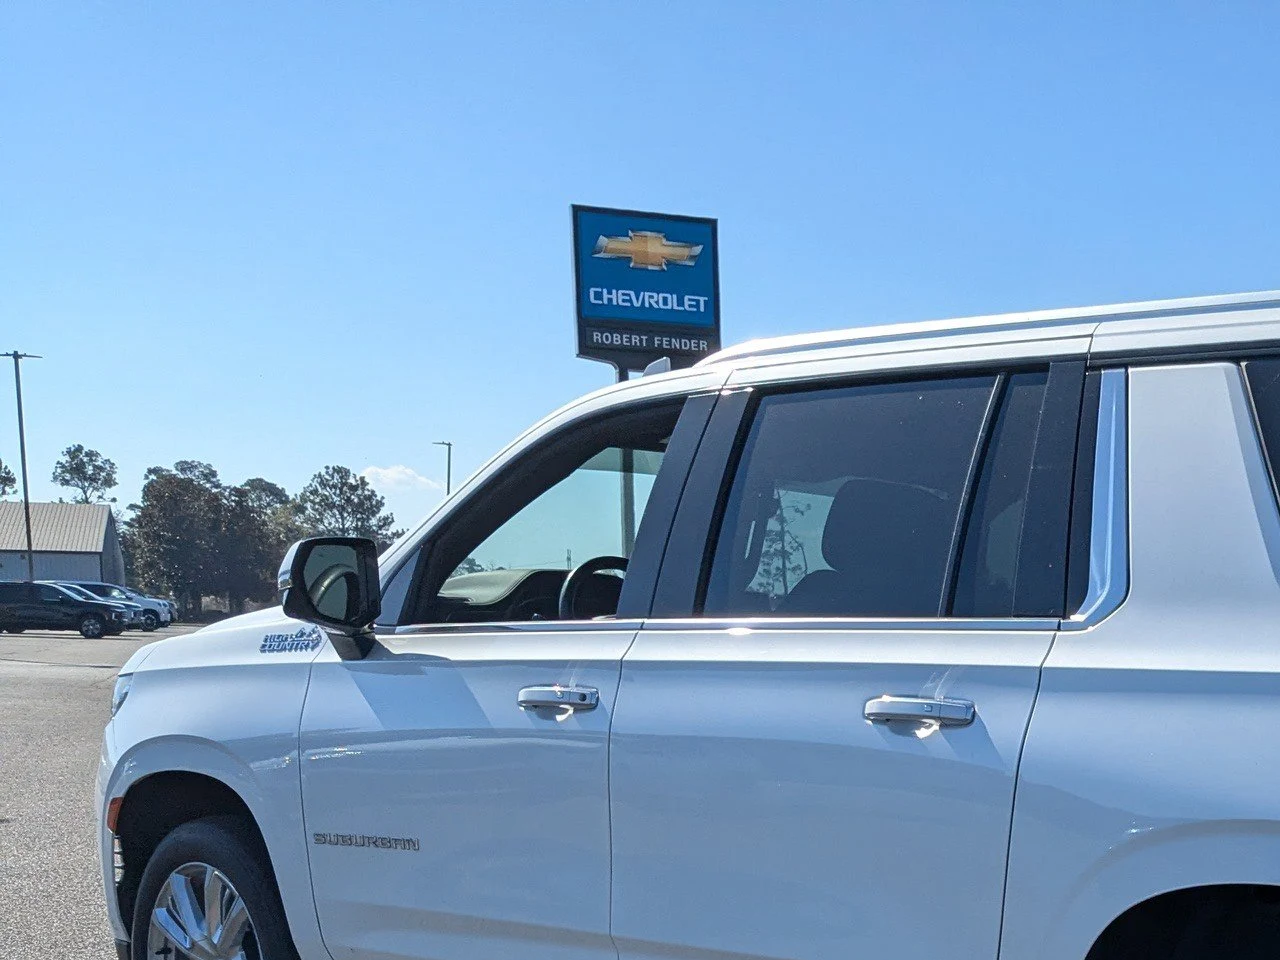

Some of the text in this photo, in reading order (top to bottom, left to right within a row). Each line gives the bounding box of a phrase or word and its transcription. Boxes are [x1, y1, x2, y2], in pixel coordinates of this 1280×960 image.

[589, 287, 708, 312] CHEVROLET
[593, 332, 708, 351] ROBERT FENDER
[259, 640, 321, 653] COUNTRY
[313, 833, 420, 851] SUBURBAN
